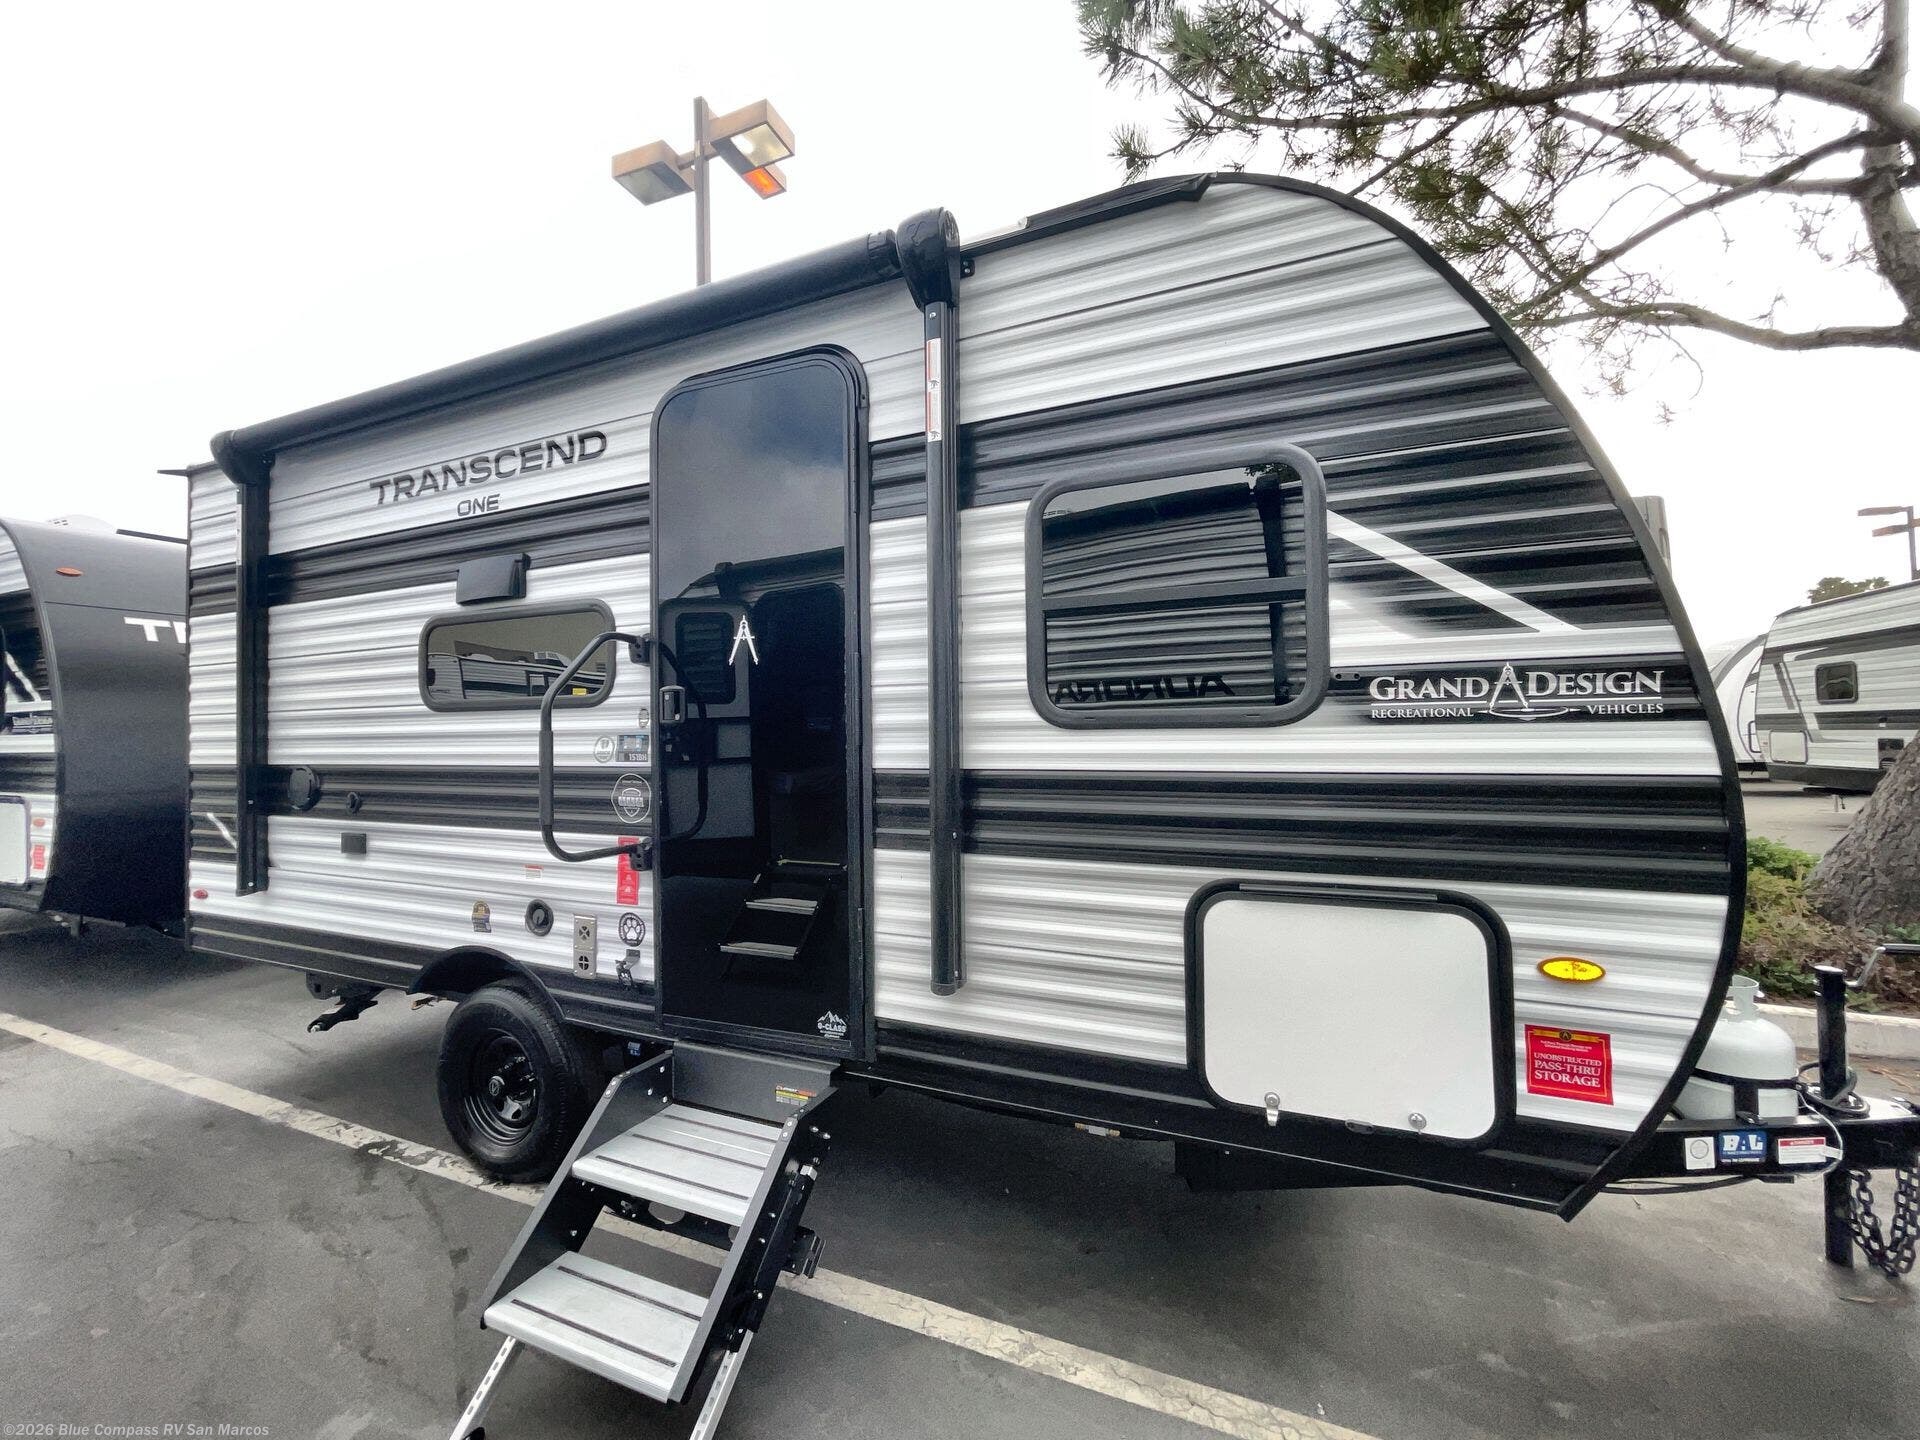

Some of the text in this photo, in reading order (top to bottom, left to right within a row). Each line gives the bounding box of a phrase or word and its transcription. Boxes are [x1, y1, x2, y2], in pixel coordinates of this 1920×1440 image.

[369, 429, 608, 505] TRANSCEND
[456, 493, 501, 518] ONE
[1369, 670, 1663, 702] GRAND DESIGN
[1371, 702, 1664, 719] RECREATIONAL VEHICLES
[1533, 1052, 1602, 1067] UNOBSTRUCTED
[1534, 1061, 1602, 1077] PASS-THRU
[1534, 1071, 1601, 1088] STORAGE
